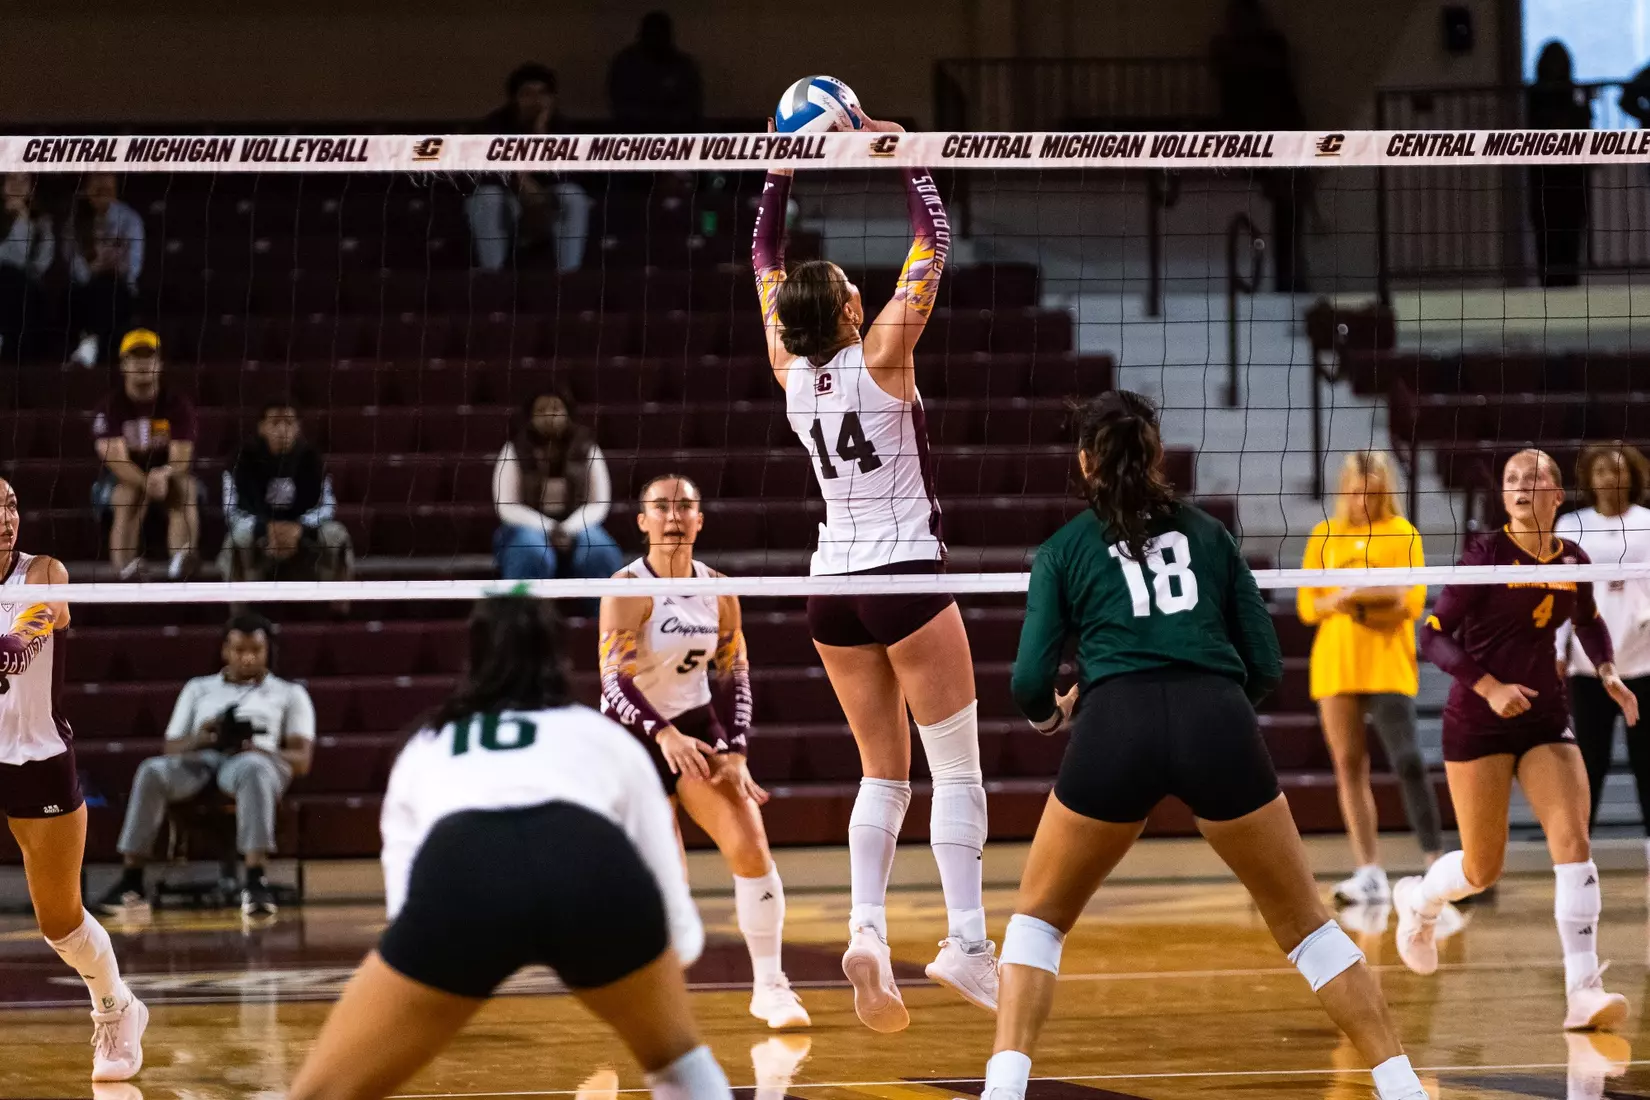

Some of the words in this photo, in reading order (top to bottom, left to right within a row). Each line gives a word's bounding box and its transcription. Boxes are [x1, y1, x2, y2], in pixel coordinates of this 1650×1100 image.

[22, 138, 118, 163] CENTRAL
[124, 138, 236, 162] MICHIGAN
[239, 138, 369, 162] VOLLEYBALL
[486, 137, 580, 161] CENTRAL
[585, 137, 696, 161] MICHIGAN
[699, 136, 827, 160] VOLLEYBALL
[941, 135, 1033, 158] CENTRAL
[1038, 135, 1147, 158] MICHIGAN
[1149, 134, 1274, 158] VOLLEYBALL
[1386, 133, 1476, 157] CENTRAL
[1481, 132, 1587, 156] MICHIGAN
[809, 411, 882, 480] 14
[1108, 531, 1199, 617] 18
[1532, 594, 1554, 628] 4
[676, 649, 706, 674] 5
[451, 712, 537, 757] 16
